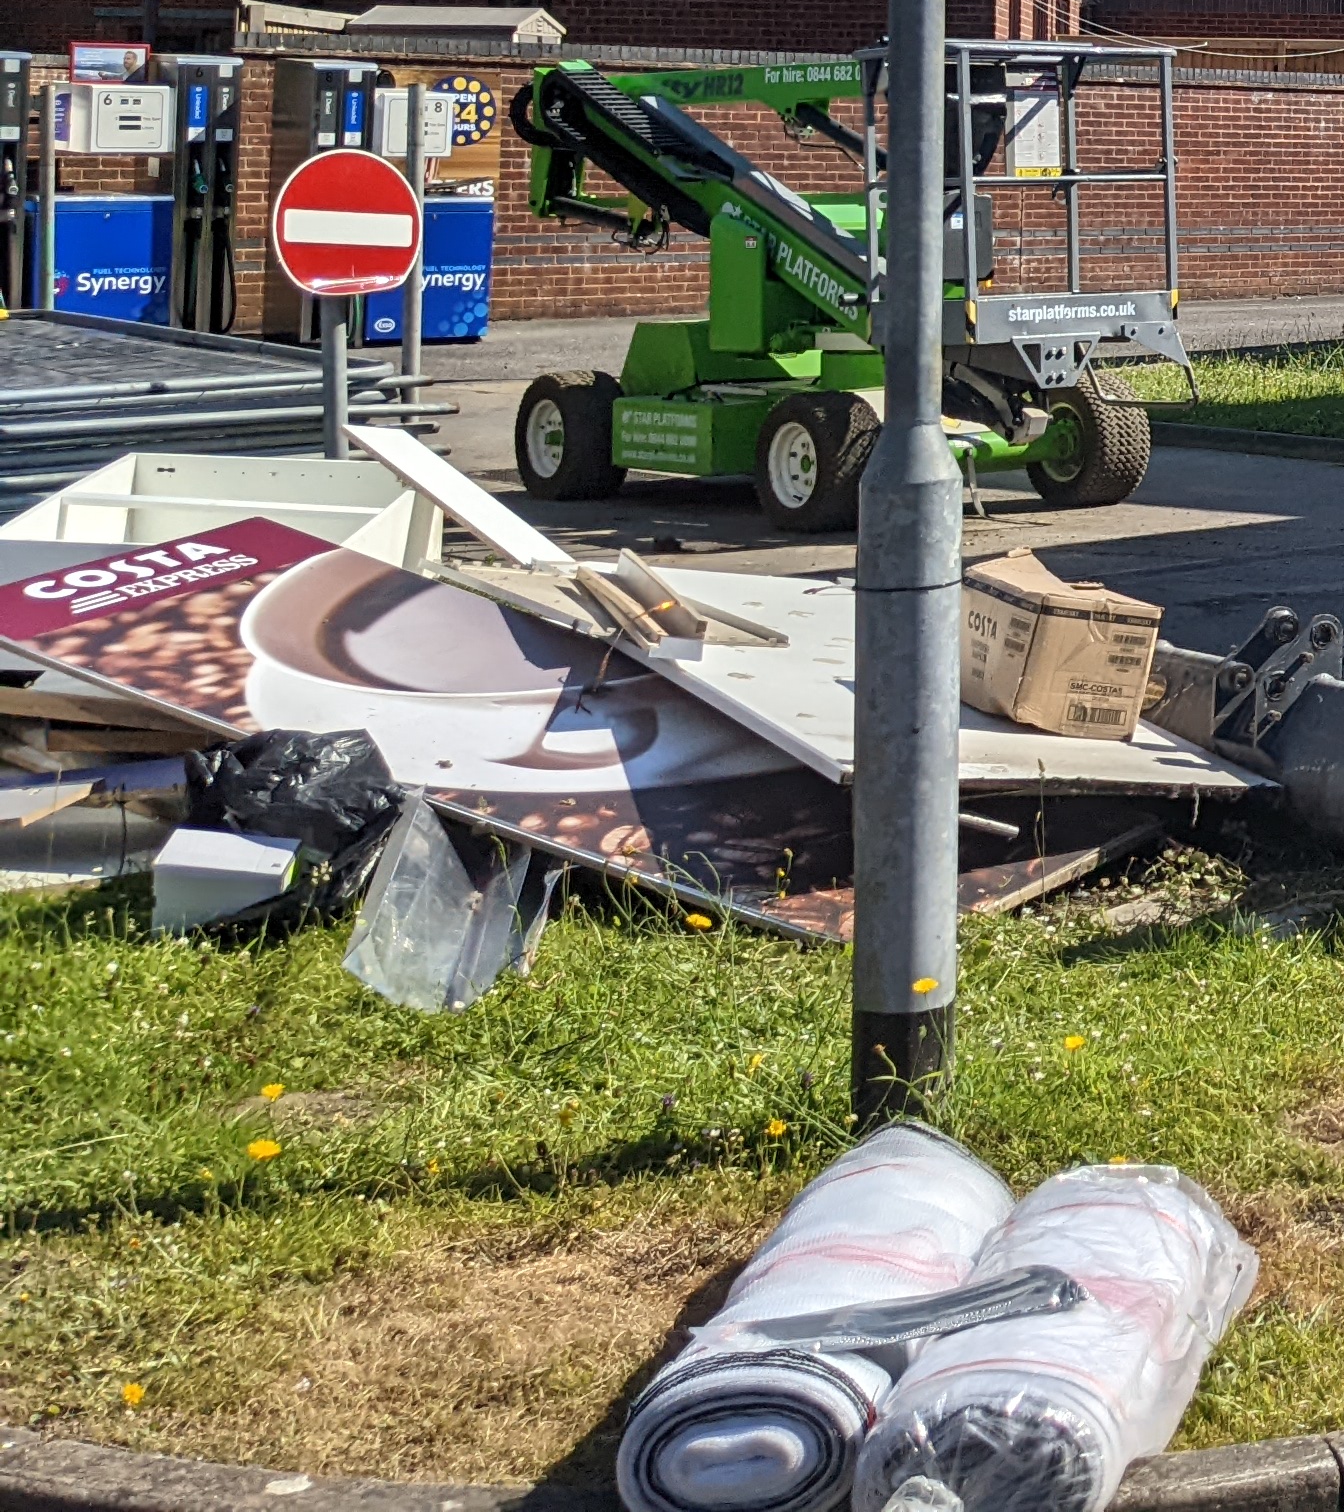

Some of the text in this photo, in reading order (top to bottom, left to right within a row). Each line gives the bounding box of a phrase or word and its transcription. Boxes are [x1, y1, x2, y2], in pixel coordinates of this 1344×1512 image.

[765, 67, 781, 84] For
[783, 66, 804, 83] hire:
[806, 65, 831, 82] 0844
[834, 65, 852, 81] 682
[103, 93, 113, 106] 6
[434, 101, 443, 113] 8
[452, 93, 477, 102] PEN
[76, 272, 166, 296] Synergy
[420, 273, 486, 292] ynergy
[1008, 301, 1136, 323] starplatforms.co.uk
[22, 541, 232, 599] COSTA
[116, 554, 259, 598] EXPRESS
[967, 610, 998, 640] COSTA
